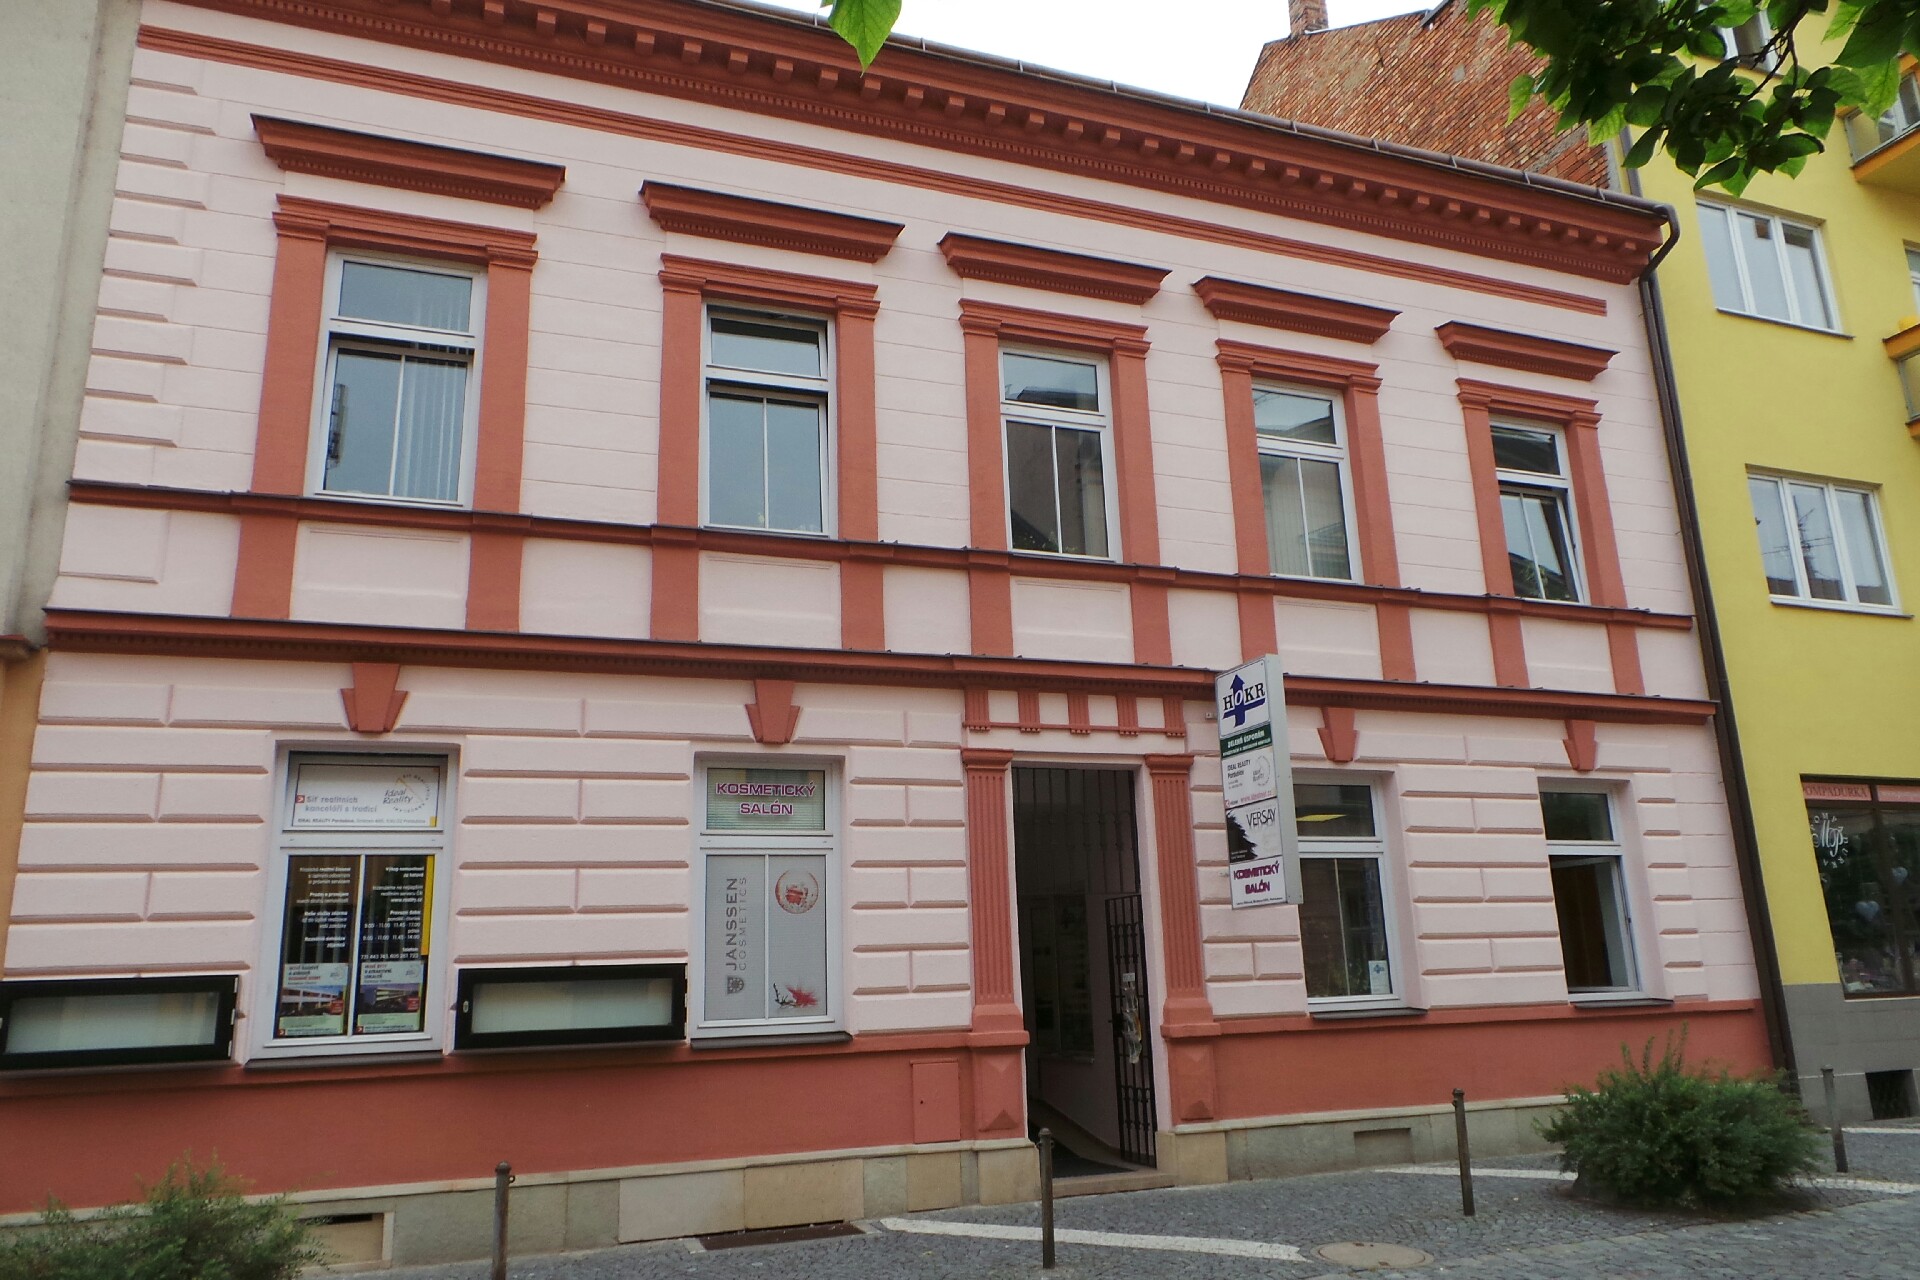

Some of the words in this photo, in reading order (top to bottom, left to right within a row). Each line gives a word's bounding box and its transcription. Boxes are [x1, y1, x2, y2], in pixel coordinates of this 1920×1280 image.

[1223, 682, 1265, 711] HOKR
[384, 789, 407, 797] Ideal
[716, 782, 816, 797] KOSMETICKÝ
[1803, 785, 1868, 798] OMPADURKA
[320, 795, 359, 804] realitních
[382, 795, 413, 805] Reality
[740, 800, 794, 815] SALÓN
[1246, 808, 1277, 826] VERSAY
[725, 878, 738, 971] JANSSEN
[739, 876, 747, 971] COSMETICS
